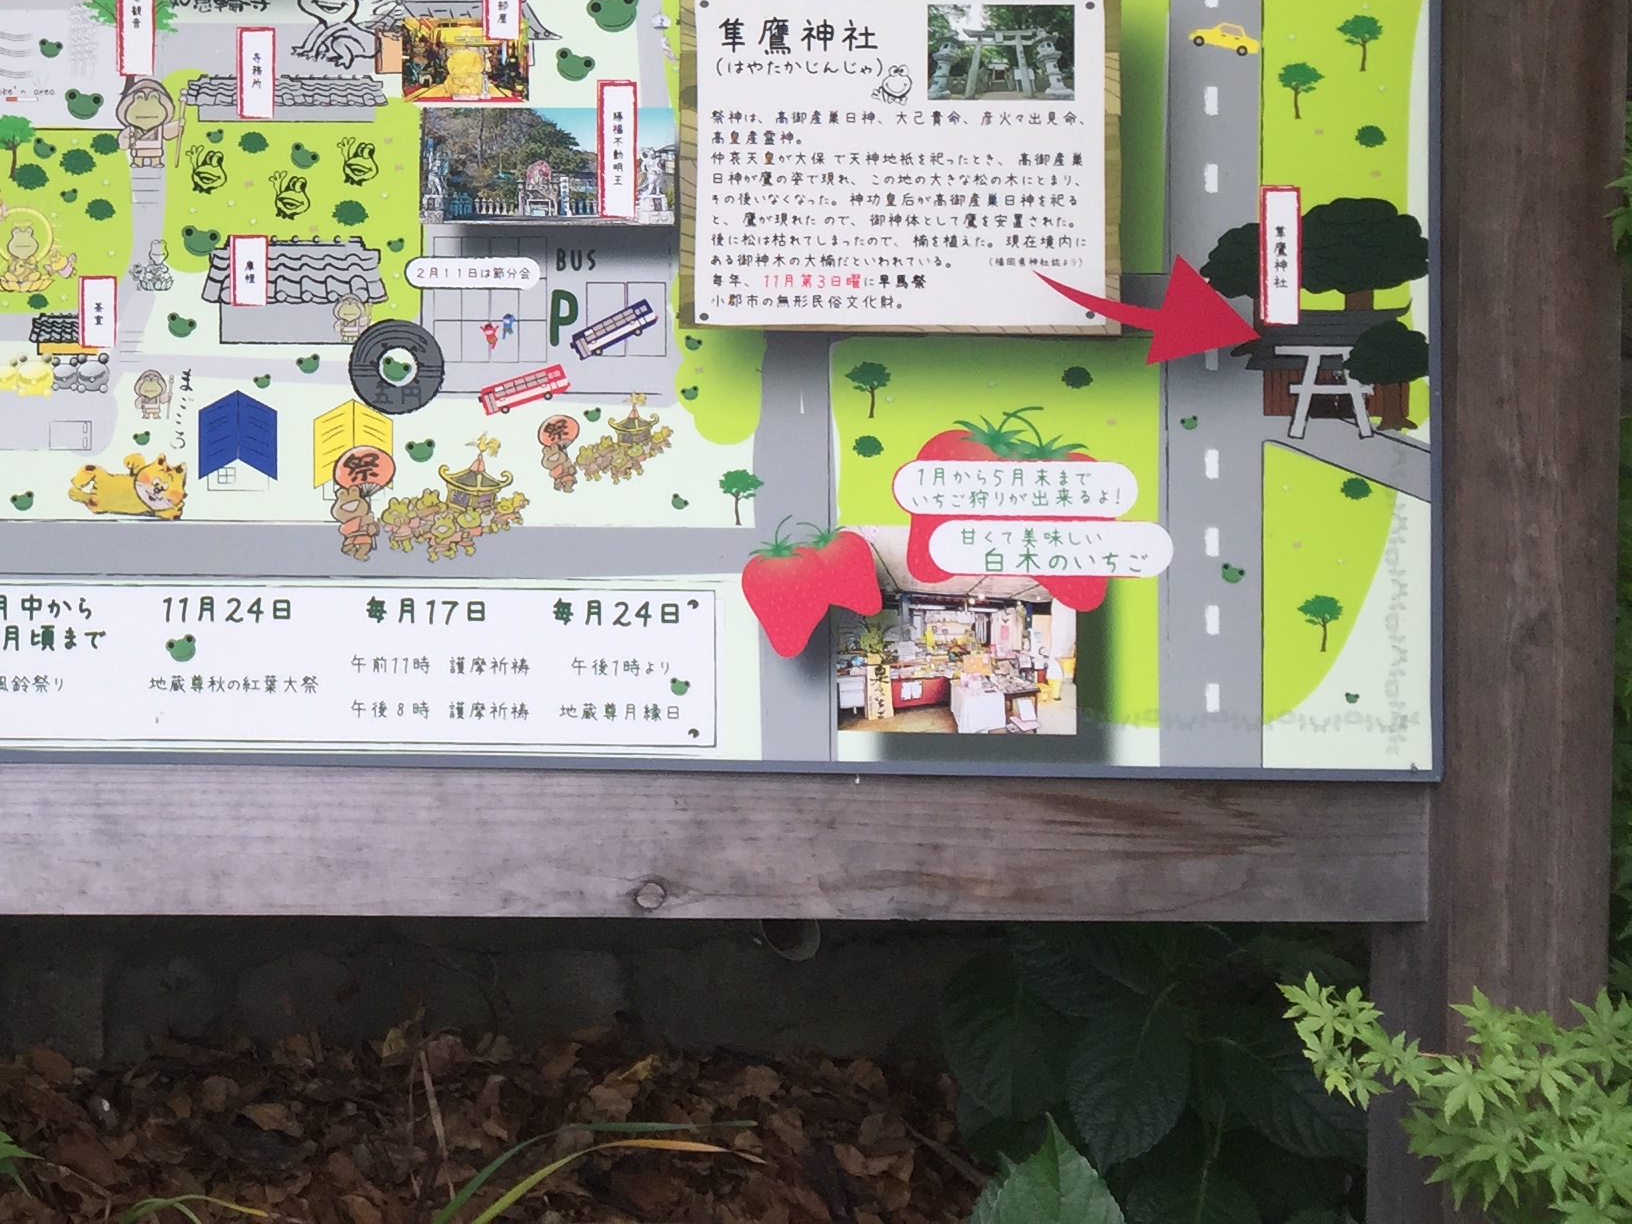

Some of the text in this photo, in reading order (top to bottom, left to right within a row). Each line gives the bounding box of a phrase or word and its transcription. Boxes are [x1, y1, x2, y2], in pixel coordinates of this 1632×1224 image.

[718, 12, 882, 58] 隼鷹神社
[416, 266, 531, 280] 2月11日は節分会
[552, 244, 600, 276] BUS
[548, 287, 580, 347] P
[541, 416, 571, 449] 祭
[340, 450, 380, 486] 祭
[917, 467, 1092, 488] 1月から5月末まで
[960, 527, 1102, 547] 甘くて美味しい
[984, 543, 1149, 574] 白木のいちご
[162, 595, 291, 624] 11月24日
[365, 595, 486, 626] 毎月17日
[548, 594, 682, 630] 毎月24日
[350, 654, 530, 676] 午前11時 護摩祈祷
[570, 656, 670, 678] 午後1時より
[148, 674, 319, 694] 地蔵尊秋の紅葉大祭
[448, 700, 530, 721] 護摩祈祷
[559, 702, 680, 722] 地蔵尊月縁日
